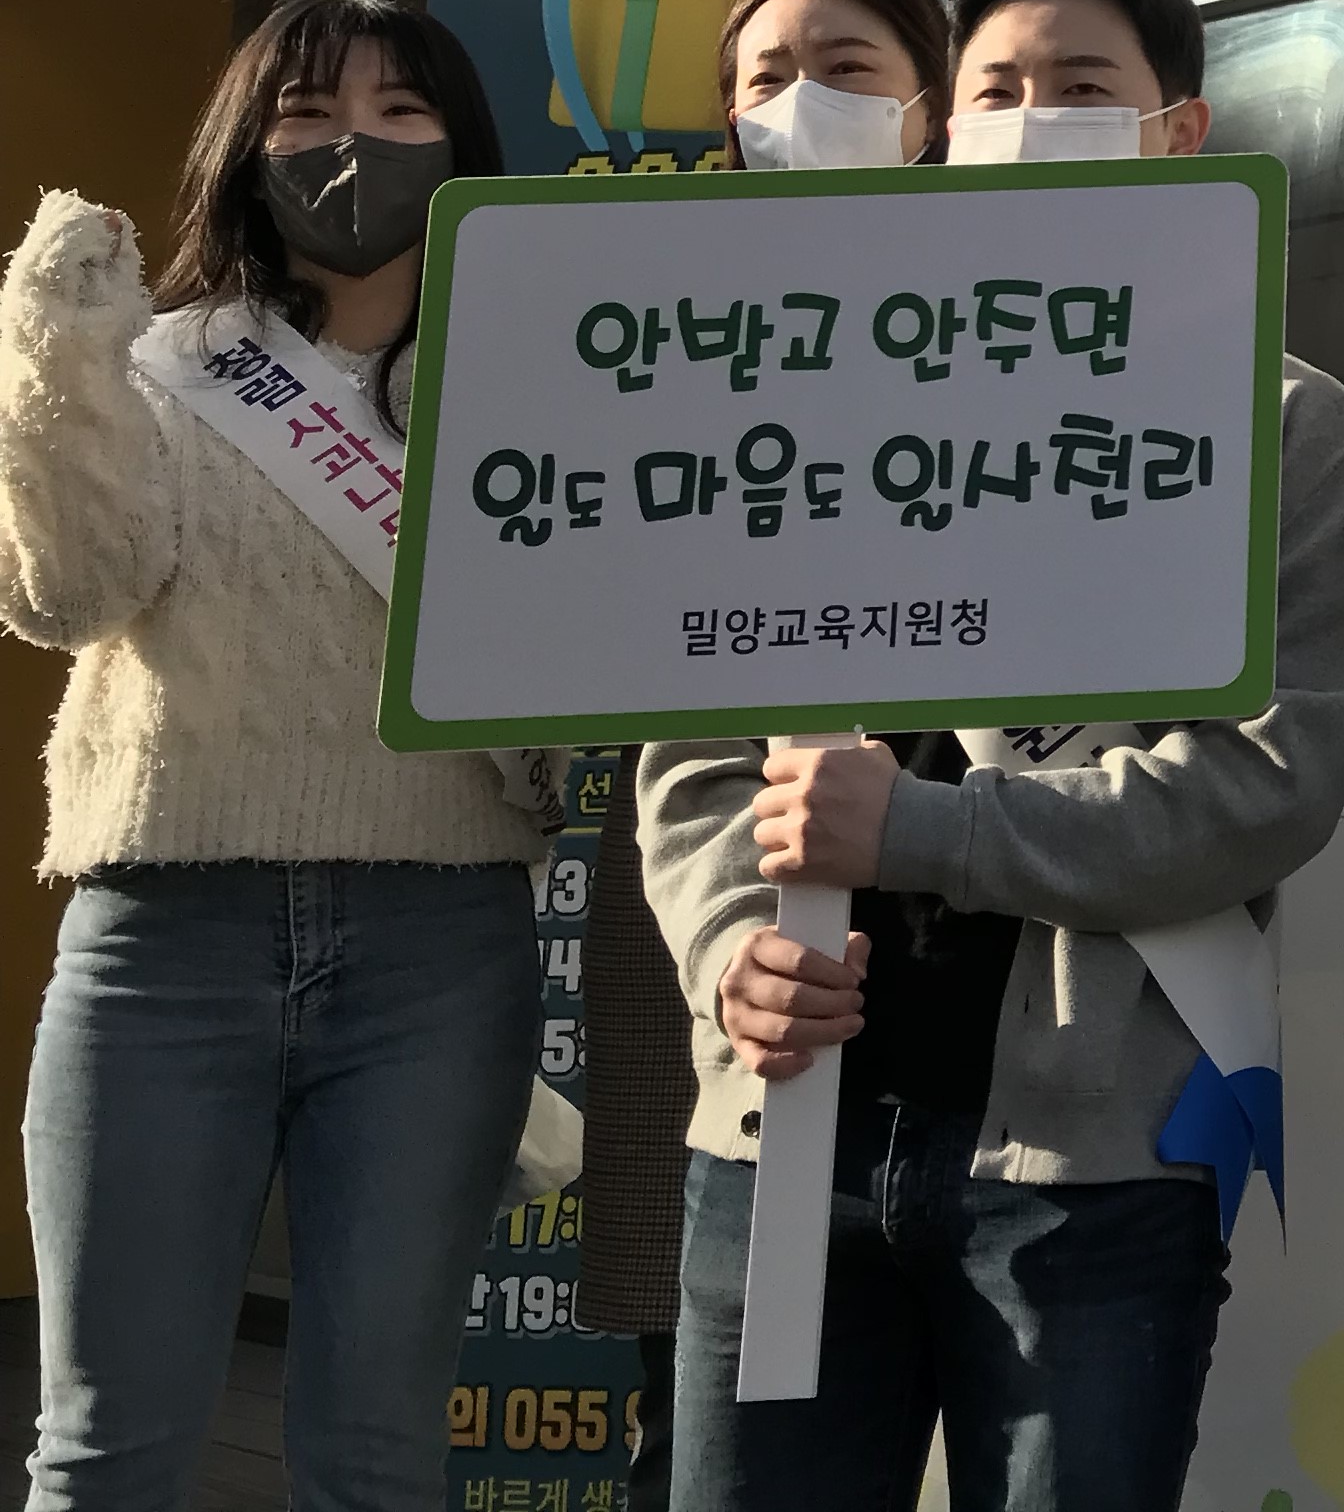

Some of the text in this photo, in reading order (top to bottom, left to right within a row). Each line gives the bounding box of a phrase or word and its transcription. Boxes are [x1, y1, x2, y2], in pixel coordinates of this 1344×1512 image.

[576, 279, 1134, 393] 안받고 안주면
[203, 336, 308, 412] 청렴
[472, 412, 1214, 547] 일도 마음도 일사천리
[681, 598, 990, 657] 밀양교육지원청
[503, 1387, 608, 1451] 055
[464, 1477, 569, 1512] 바르게
